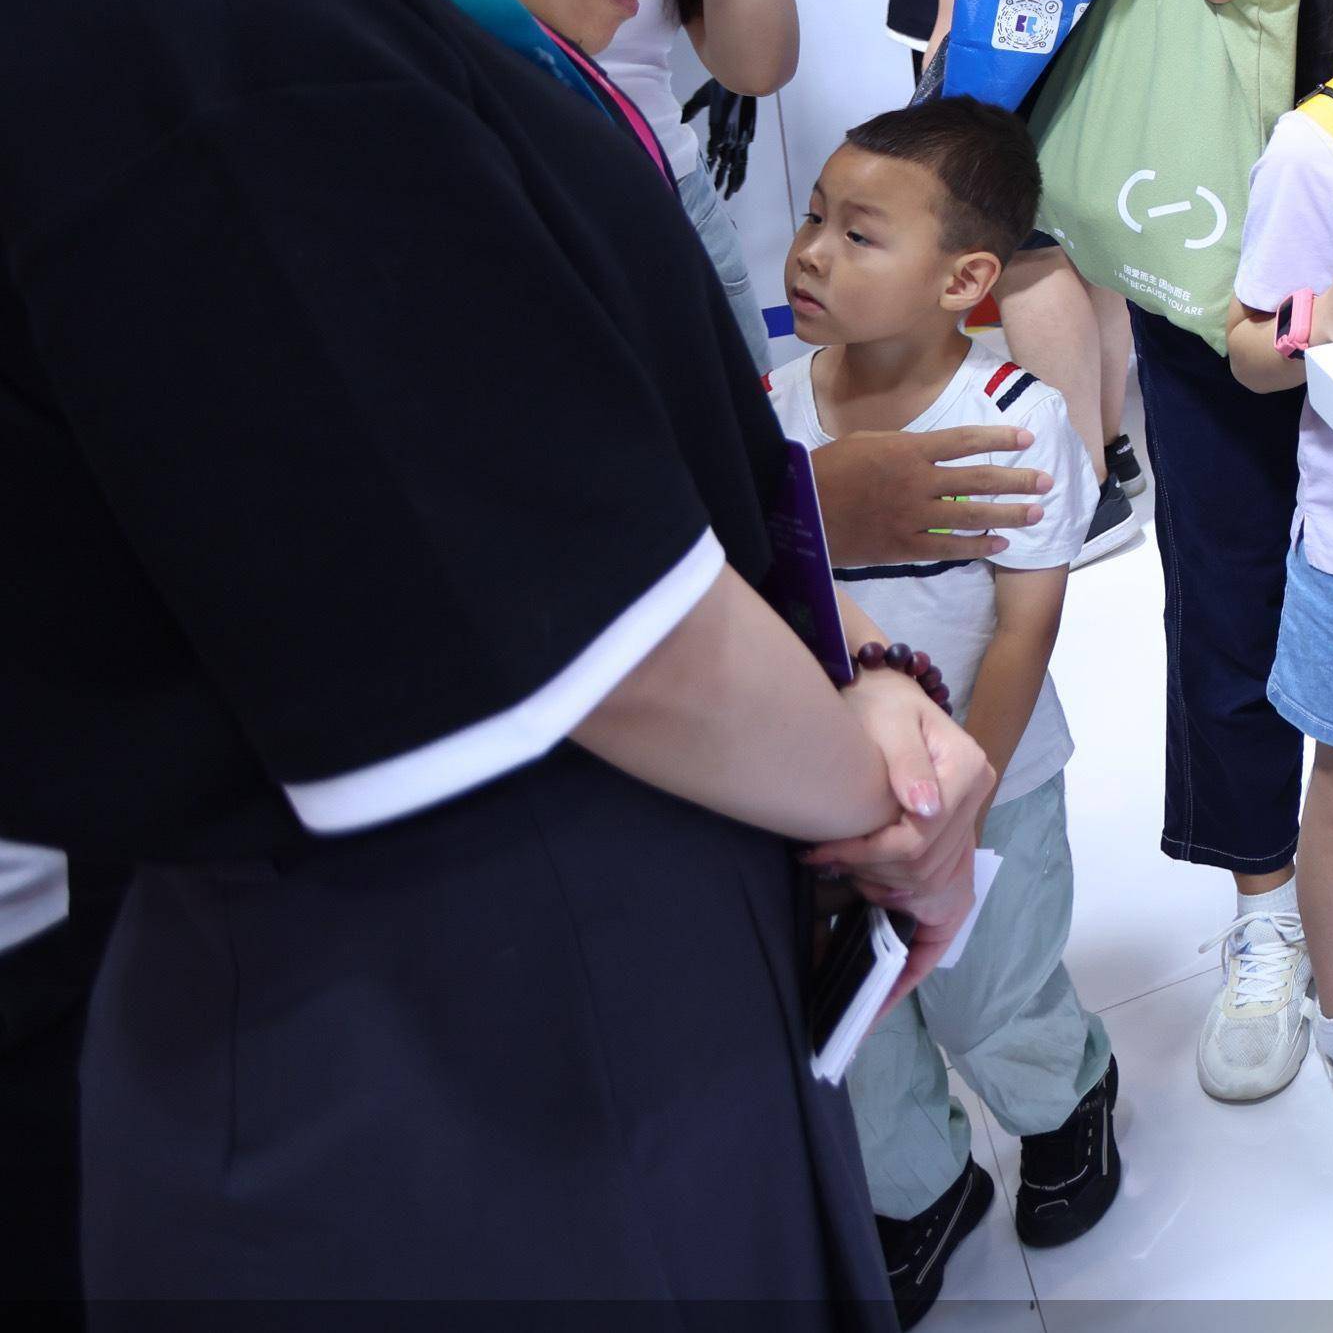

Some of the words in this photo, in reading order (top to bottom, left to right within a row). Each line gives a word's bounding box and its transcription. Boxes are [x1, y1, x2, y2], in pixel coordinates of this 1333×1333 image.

[1123, 264, 1157, 286] 因爱而生
[1129, 278, 1168, 303] BECAUSE
[1167, 296, 1184, 312] YOU
[1184, 305, 1205, 316] ARE
